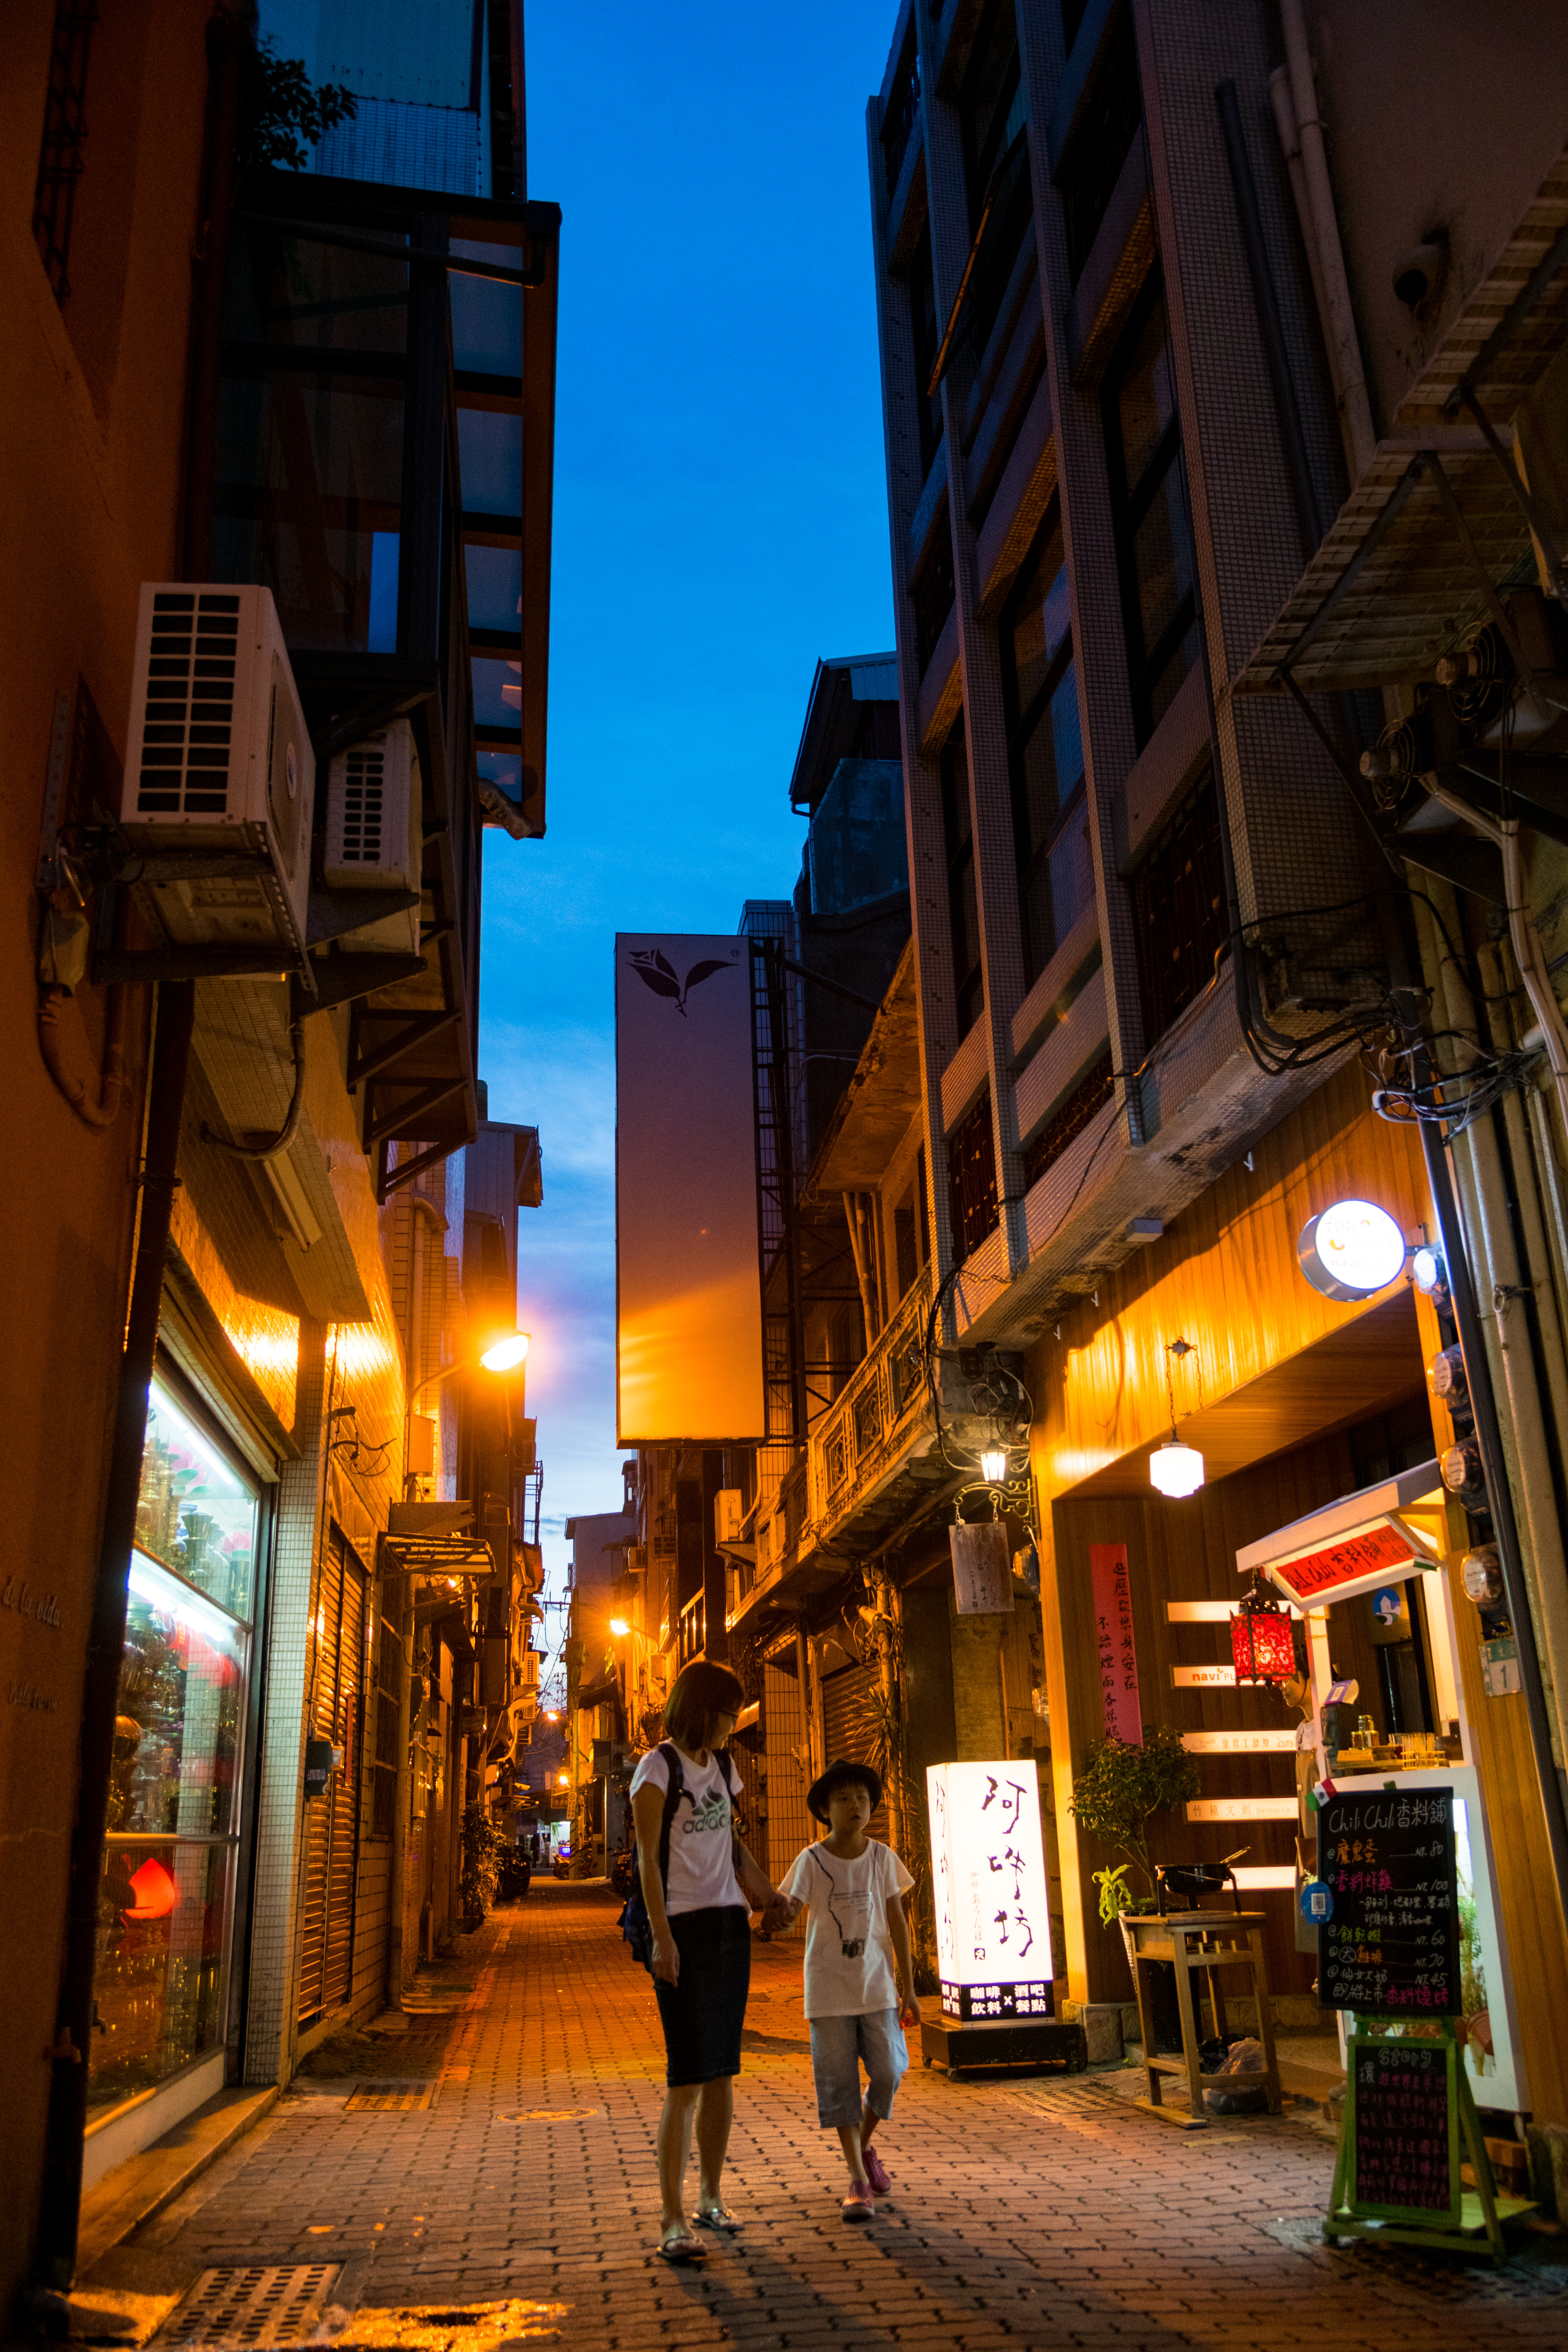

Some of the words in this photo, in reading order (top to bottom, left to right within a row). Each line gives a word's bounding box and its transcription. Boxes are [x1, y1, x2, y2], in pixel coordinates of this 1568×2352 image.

[1192, 1673, 1220, 1681] navi
[1501, 1665, 1508, 1688] 1
[1329, 1807, 1361, 1833] Chili
[1364, 1803, 1394, 1829] Chili
[1430, 1840, 1443, 1857] 80
[1430, 1878, 1448, 1891] 100
[1431, 1929, 1445, 1946] 60
[1430, 1972, 1448, 1987] 45
[1378, 2047, 1432, 2068] Story
